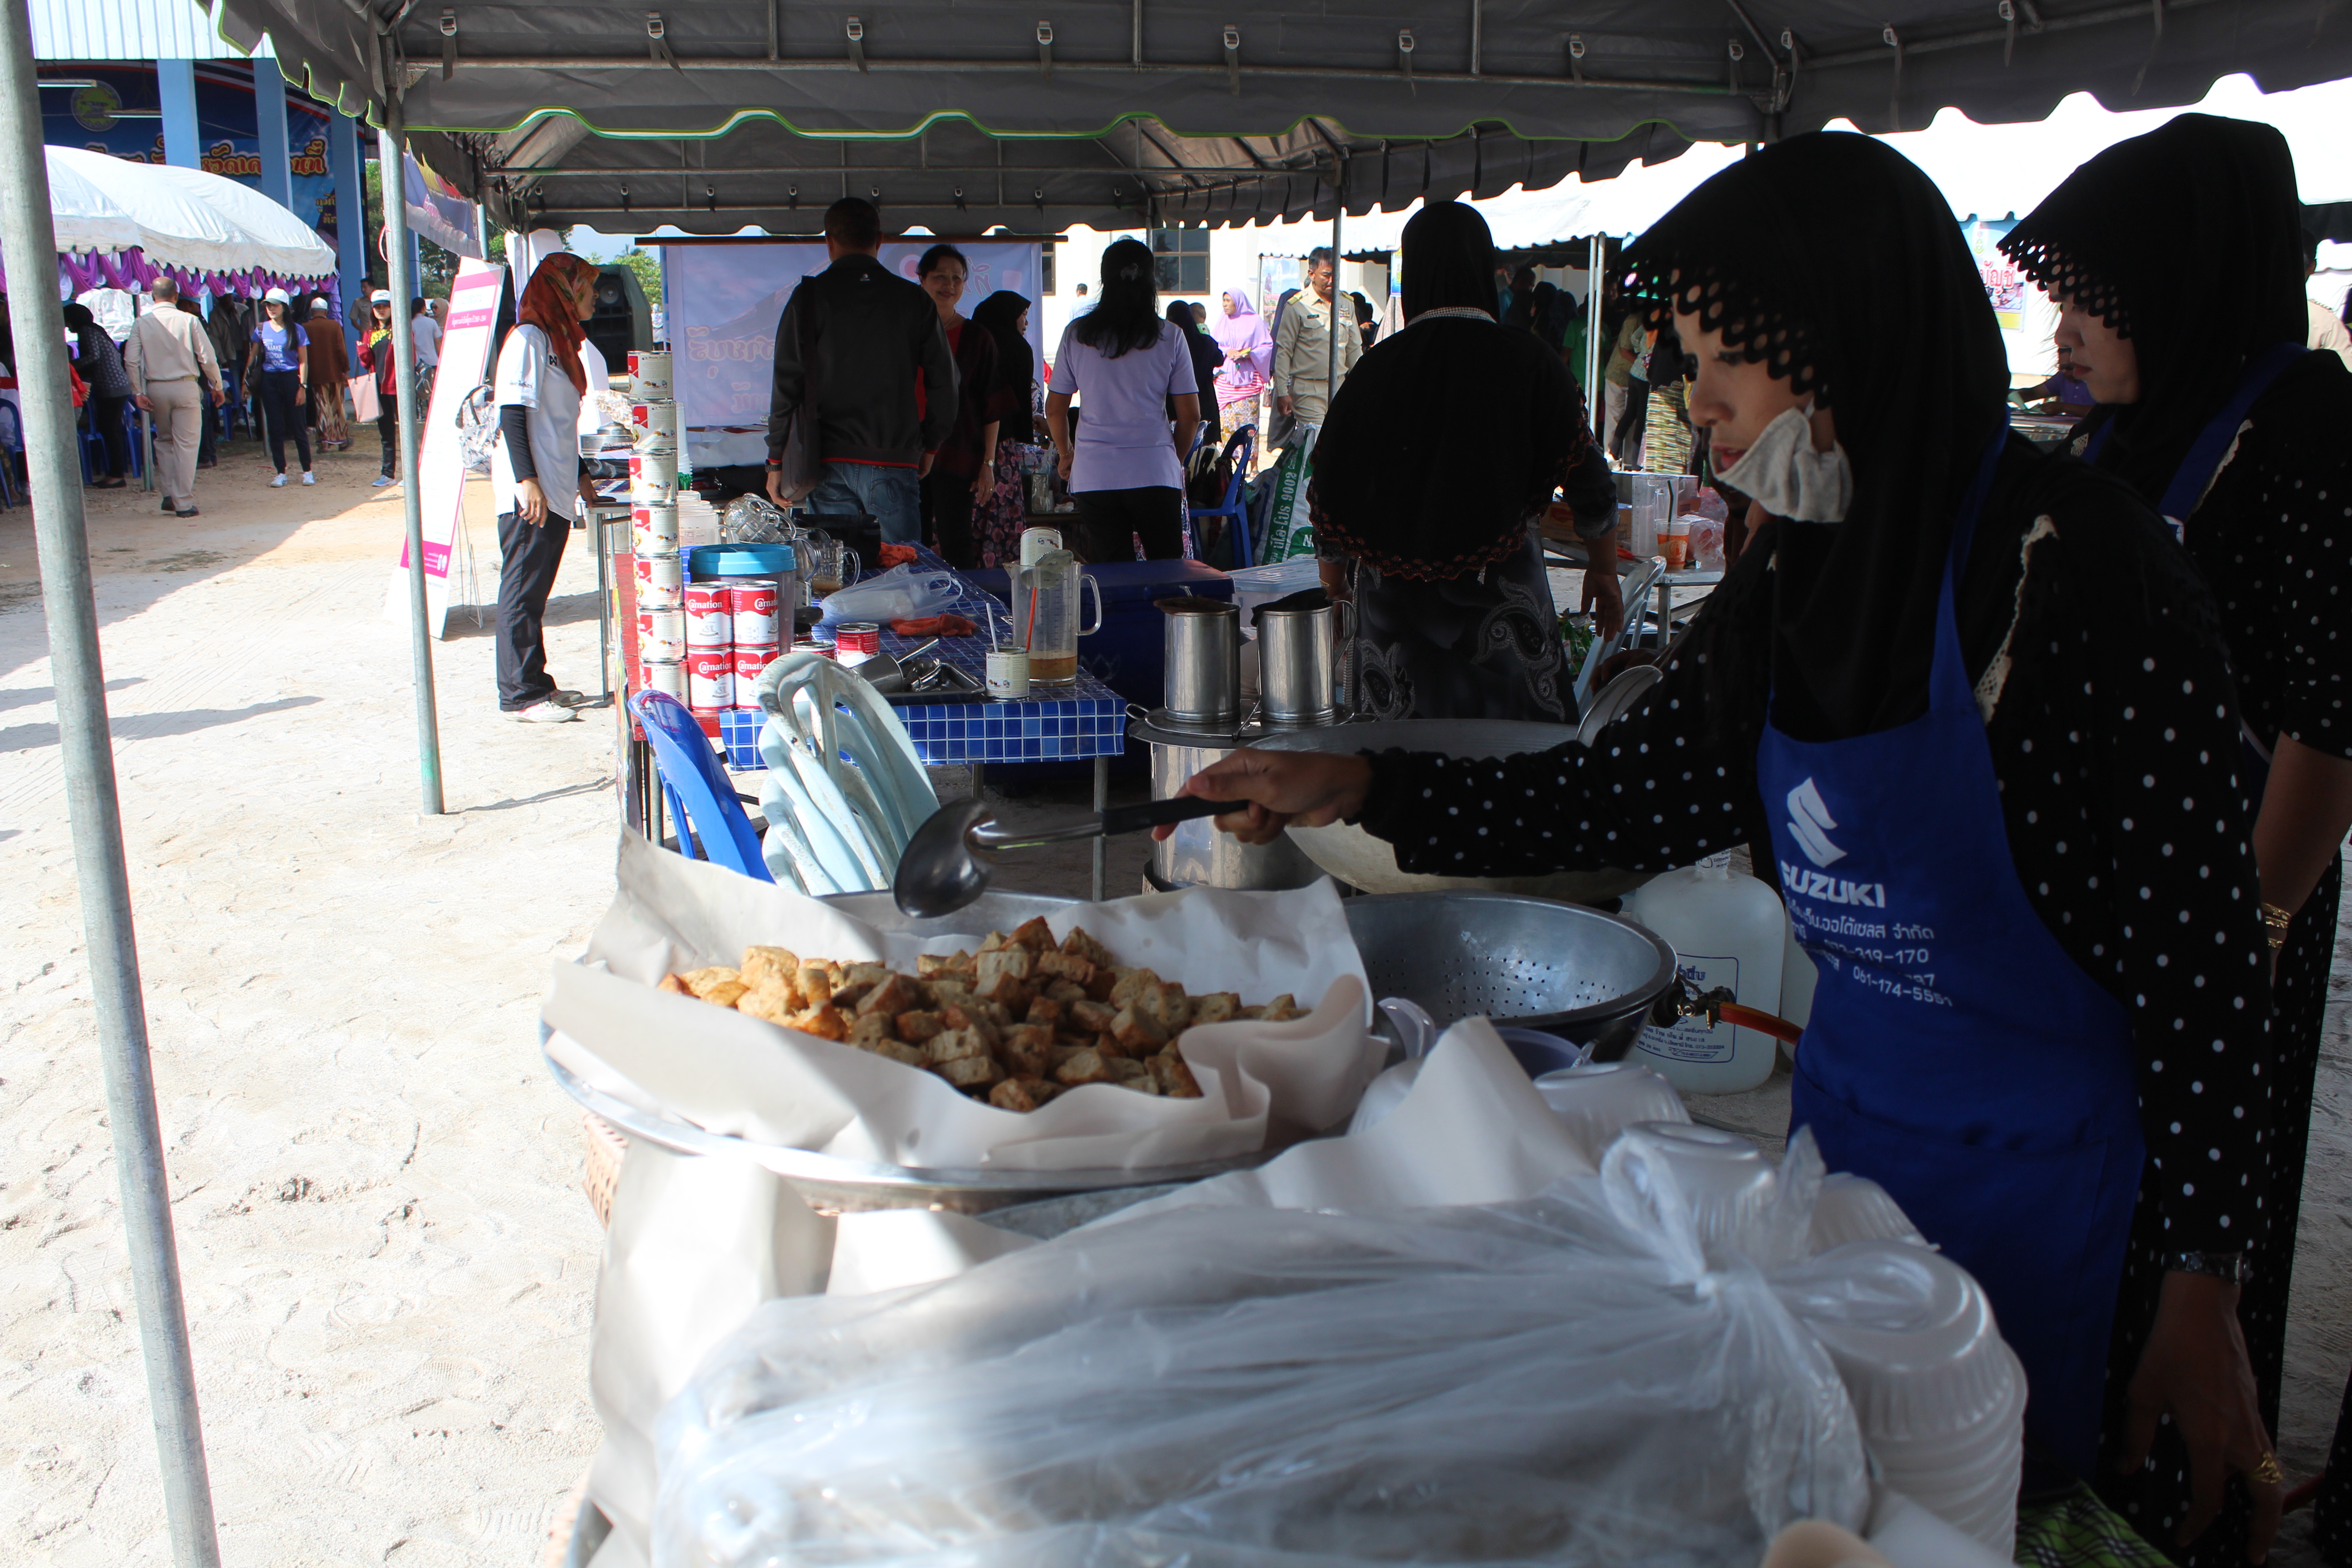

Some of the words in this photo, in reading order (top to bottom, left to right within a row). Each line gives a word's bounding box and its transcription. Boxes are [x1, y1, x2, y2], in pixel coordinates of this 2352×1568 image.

[1281, 472, 1297, 501] 9002
[688, 599, 722, 611] Carnation
[698, 662, 732, 674] Carnation
[737, 660, 767, 672] Carnatio
[1781, 860, 1885, 908] SUZUKI
[1893, 923, 1935, 939] จำกัด
